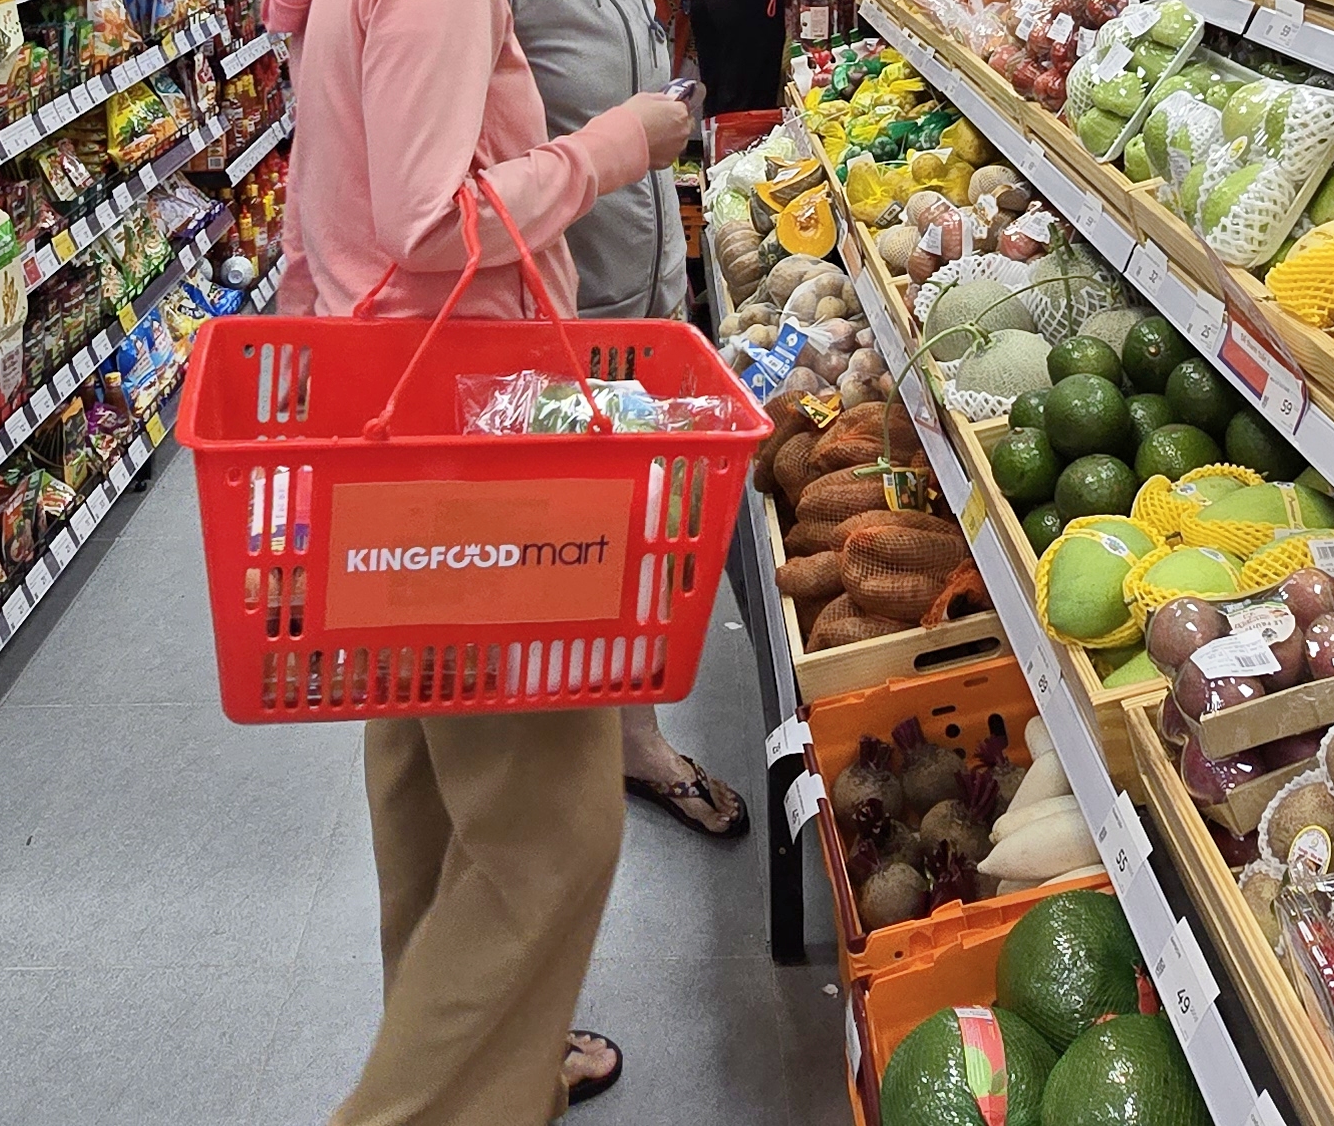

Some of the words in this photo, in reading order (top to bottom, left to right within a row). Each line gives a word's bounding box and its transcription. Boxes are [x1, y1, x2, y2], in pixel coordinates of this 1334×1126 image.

[347, 535, 609, 573] KINGFOODmart
[1115, 848, 1128, 872] 55
[1177, 989, 1190, 1014] 49
